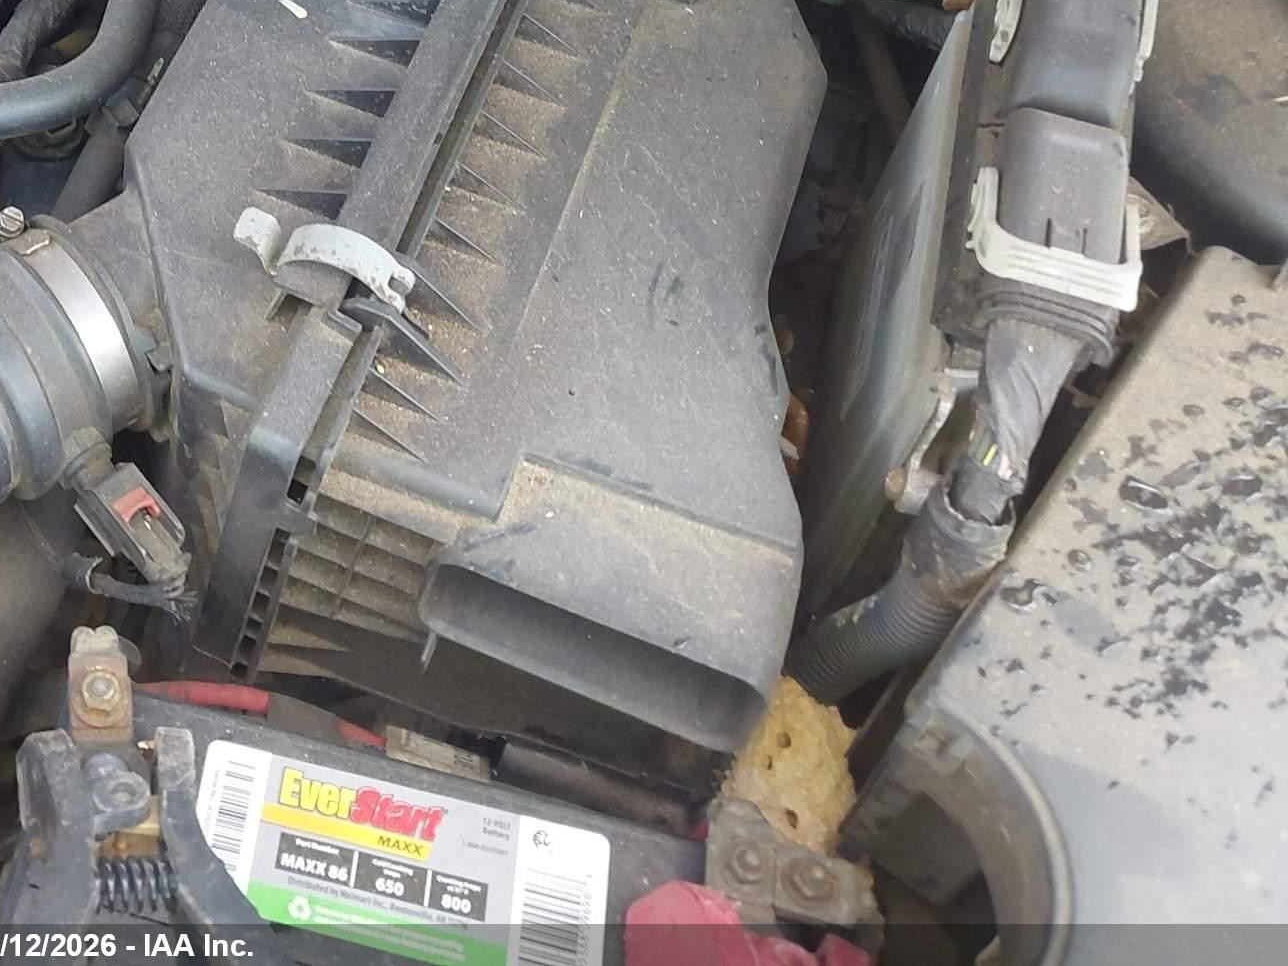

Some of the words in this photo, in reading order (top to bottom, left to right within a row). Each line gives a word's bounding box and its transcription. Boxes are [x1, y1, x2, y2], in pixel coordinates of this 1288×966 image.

[278, 766, 444, 842] EverStart
[482, 827, 510, 841] Battery
[377, 835, 423, 857] MAXX
[280, 852, 327, 876] MAXX
[328, 865, 349, 882] 86
[375, 877, 405, 897] 650
[441, 894, 472, 914] 800
